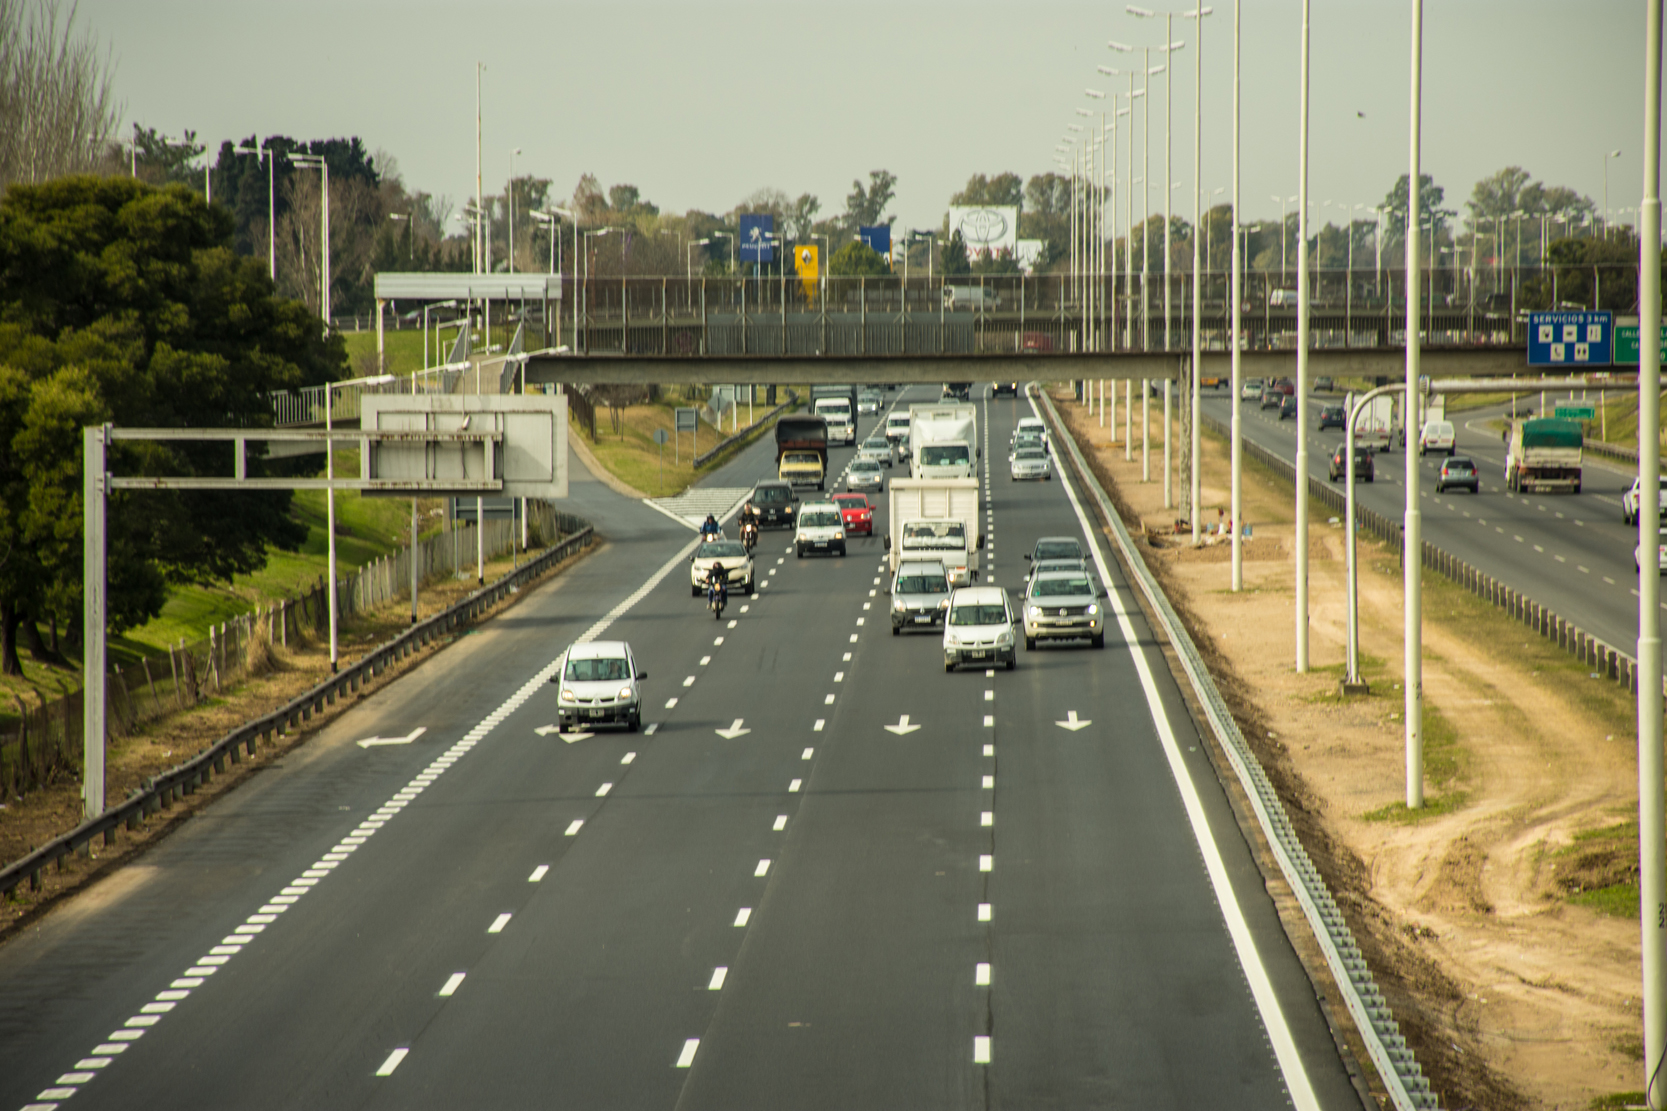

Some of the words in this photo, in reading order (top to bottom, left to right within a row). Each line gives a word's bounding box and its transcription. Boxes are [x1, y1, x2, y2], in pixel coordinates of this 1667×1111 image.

[741, 242, 771, 250] PEUGOT
[964, 246, 1012, 259] OYOTA
[1533, 314, 1584, 324] SERVICIOS
[1594, 314, 1608, 324] km
